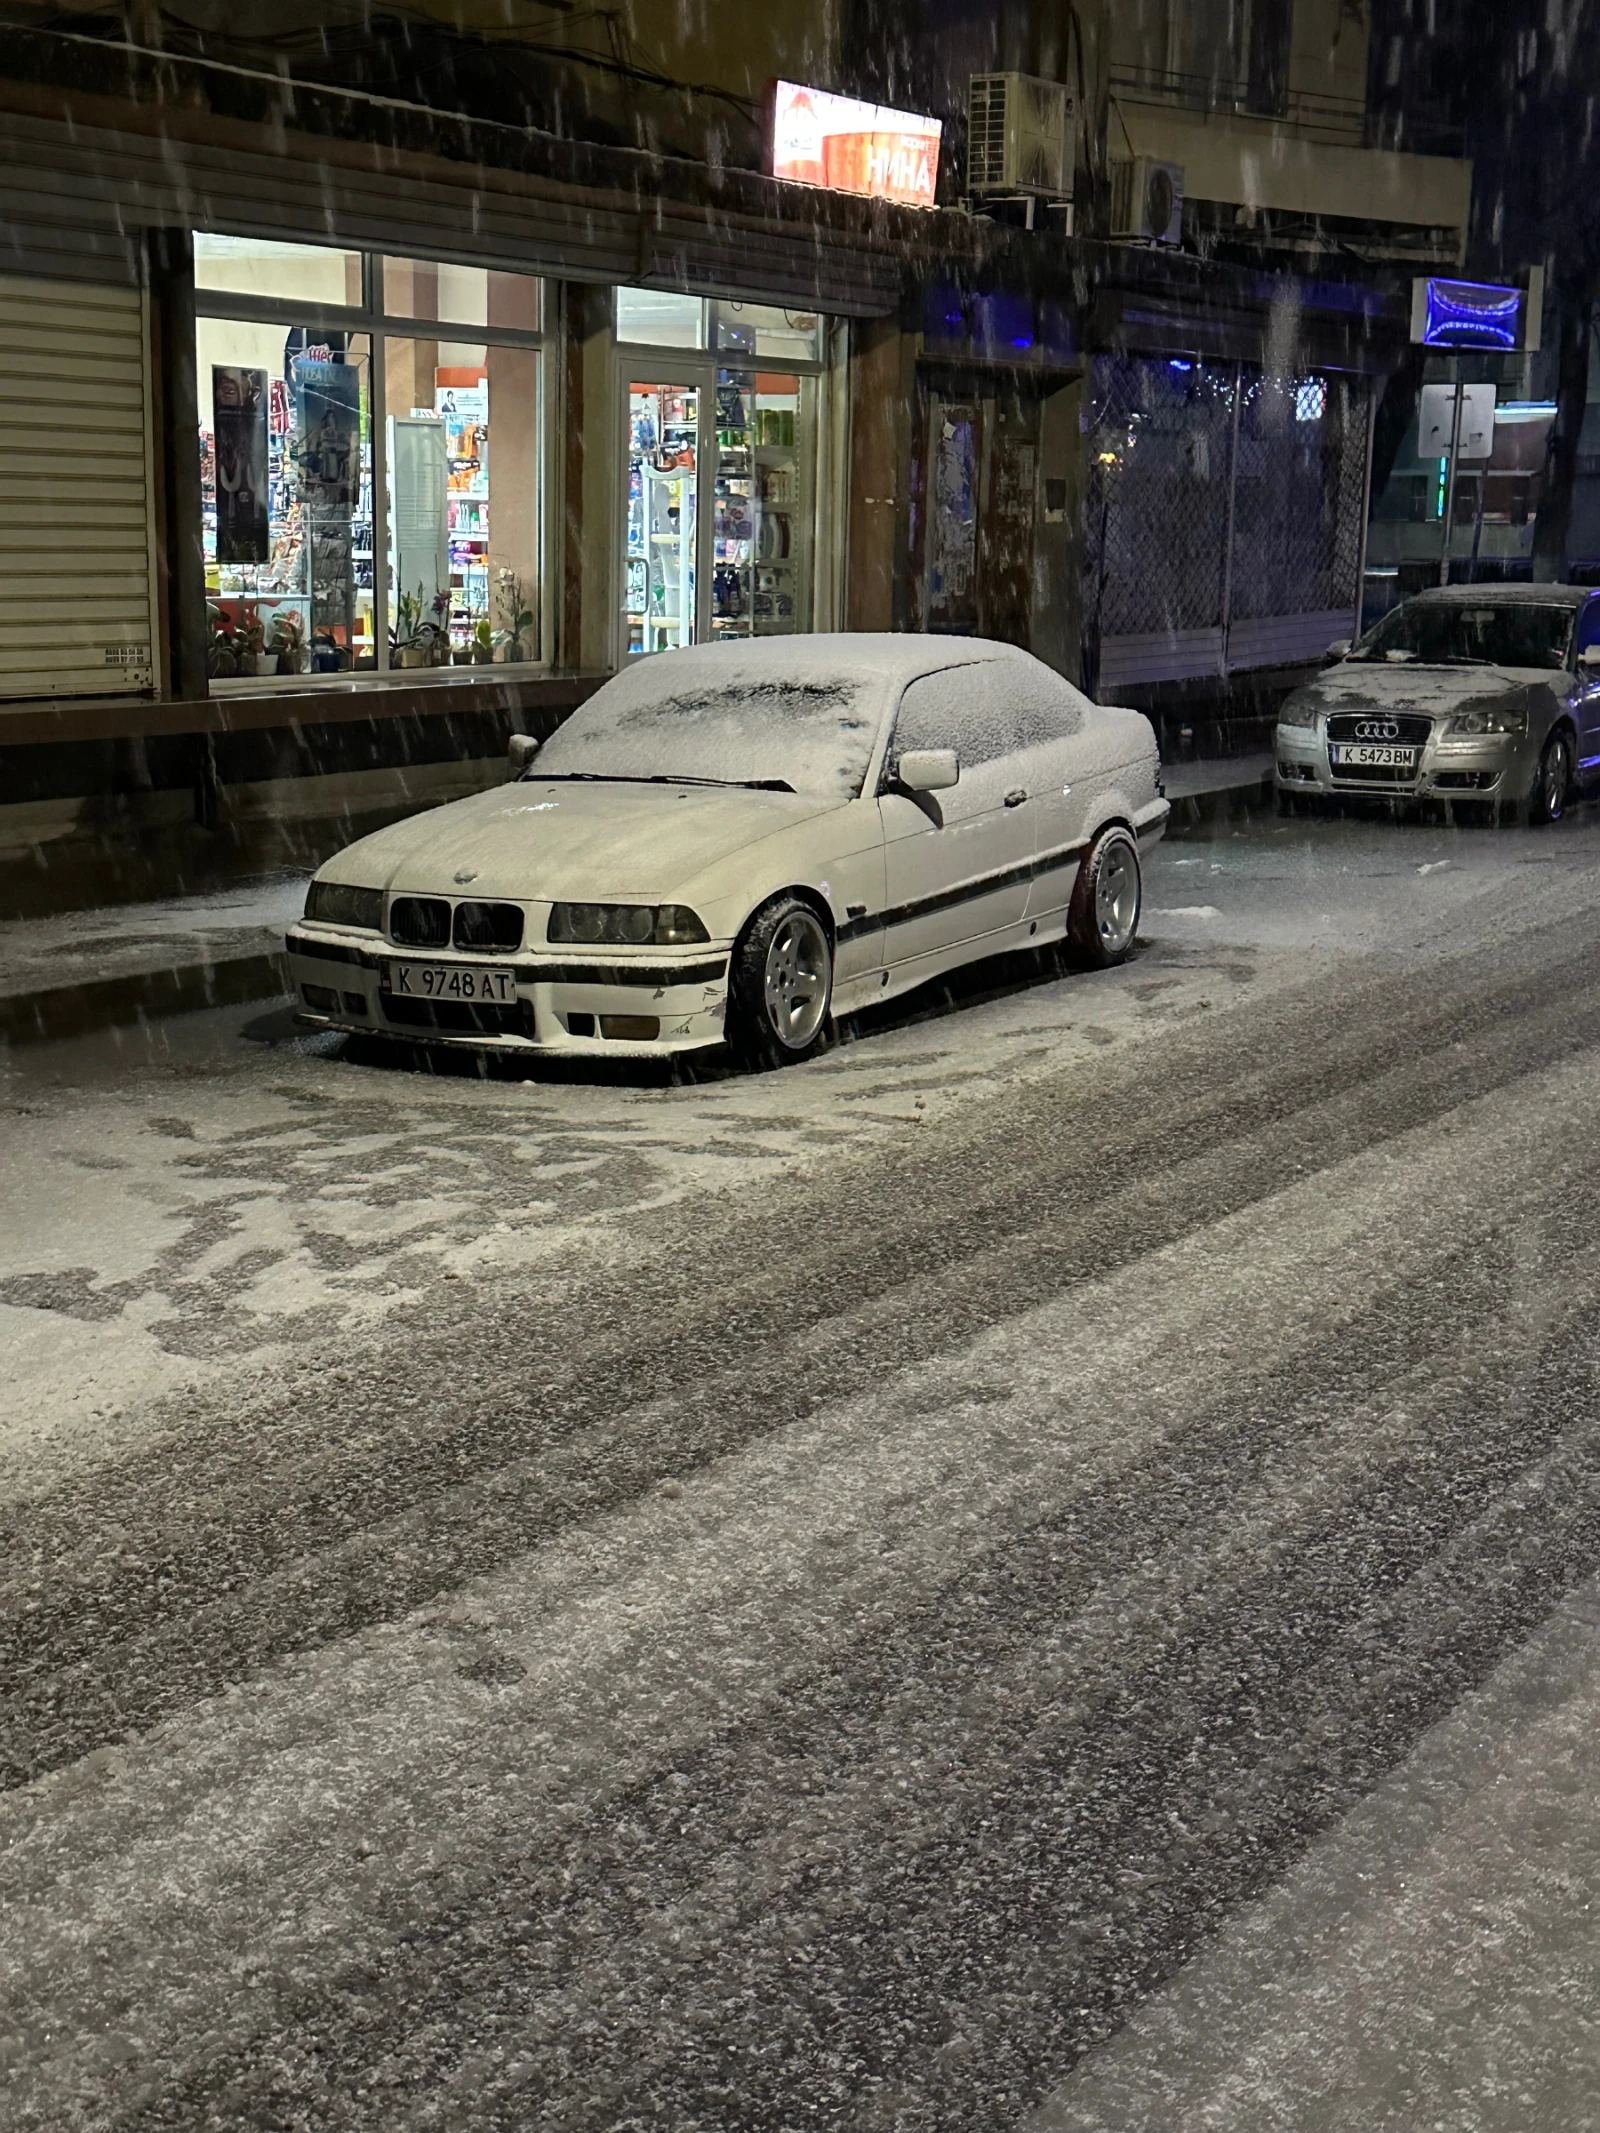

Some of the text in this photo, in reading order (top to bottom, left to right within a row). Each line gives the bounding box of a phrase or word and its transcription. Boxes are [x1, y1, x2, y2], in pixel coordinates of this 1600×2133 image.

[866, 143, 931, 194] НИНА
[1345, 748, 1353, 763] K
[1359, 748, 1392, 763] 5473
[399, 967, 509, 999] K 9748 AT
